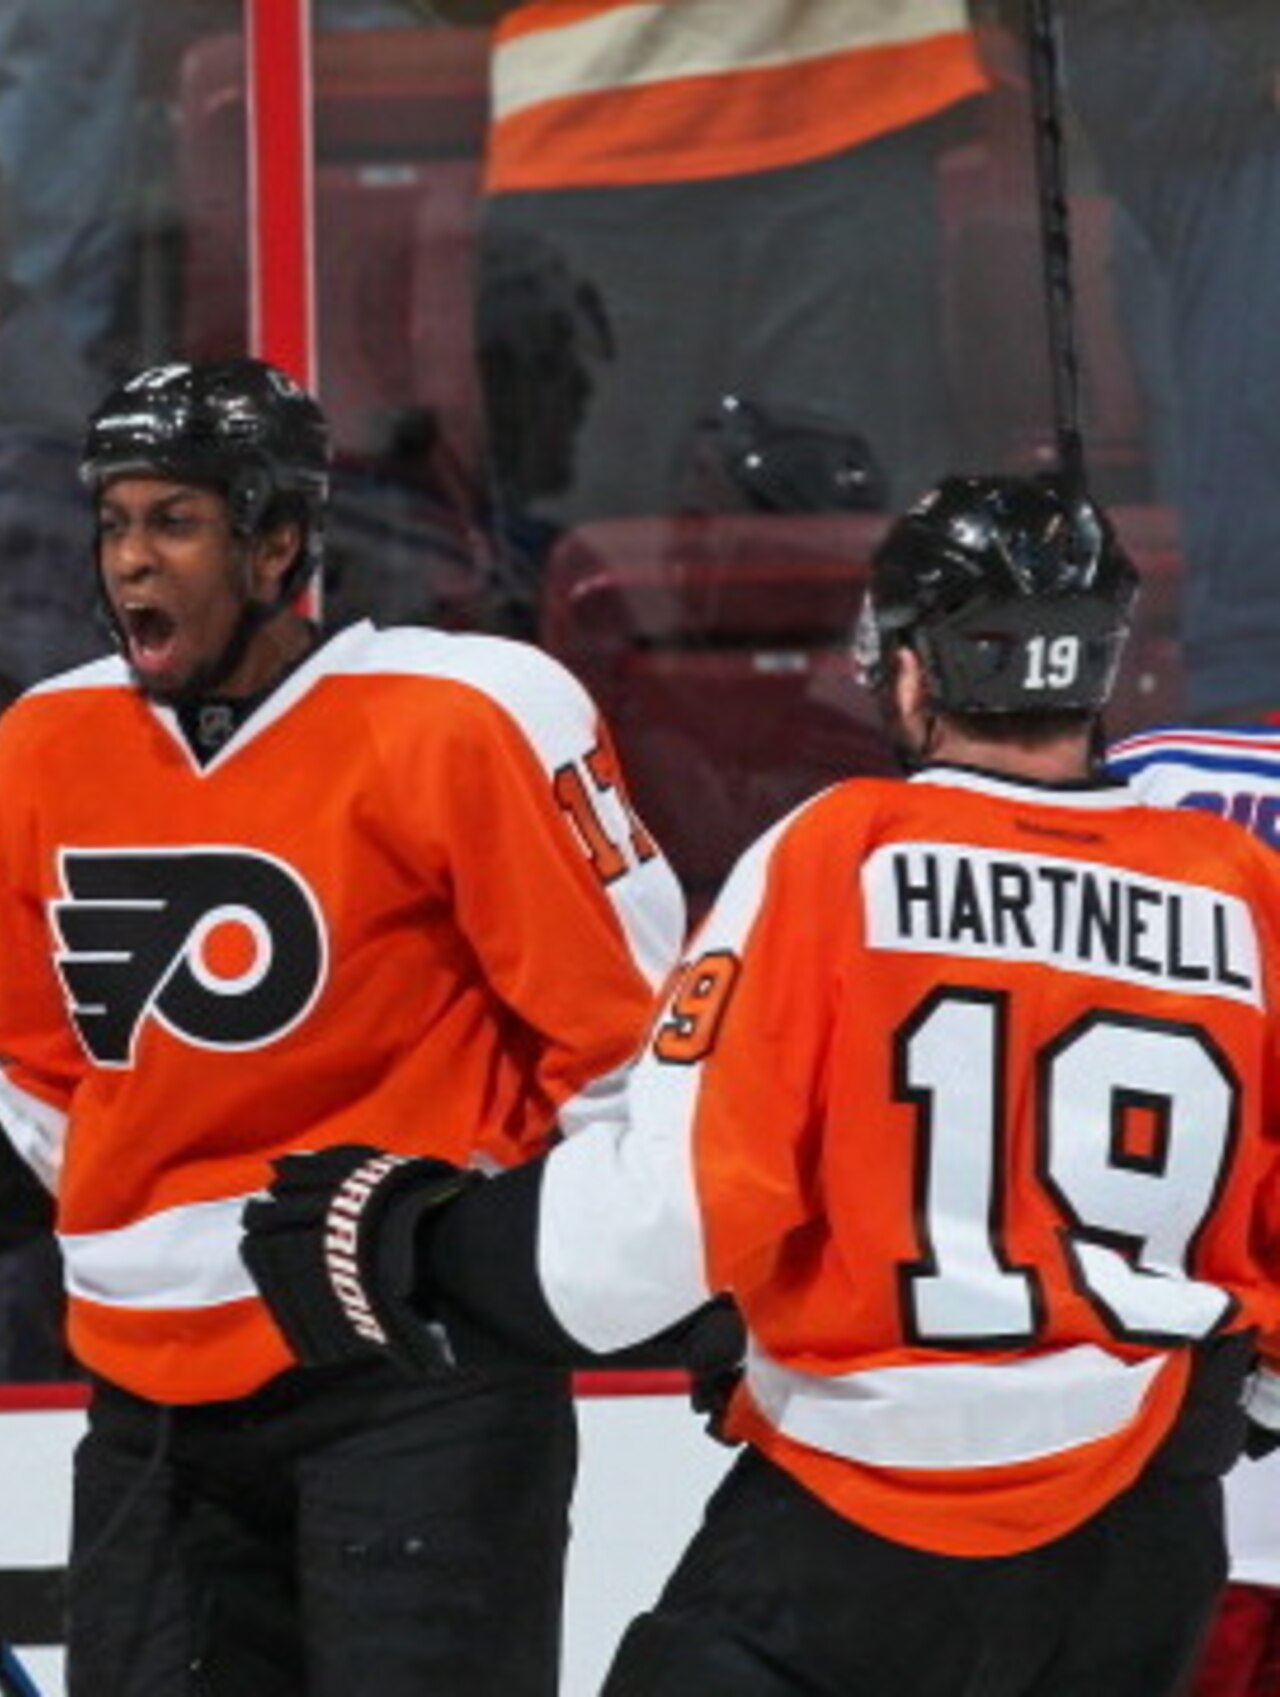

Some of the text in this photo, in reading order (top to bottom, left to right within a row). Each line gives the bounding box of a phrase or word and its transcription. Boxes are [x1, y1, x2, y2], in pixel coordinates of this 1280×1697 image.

[1024, 636, 1079, 690] 19
[893, 853, 1252, 990] HARTNELL
[654, 948, 742, 1065] 9
[891, 984, 1243, 1350] 19
